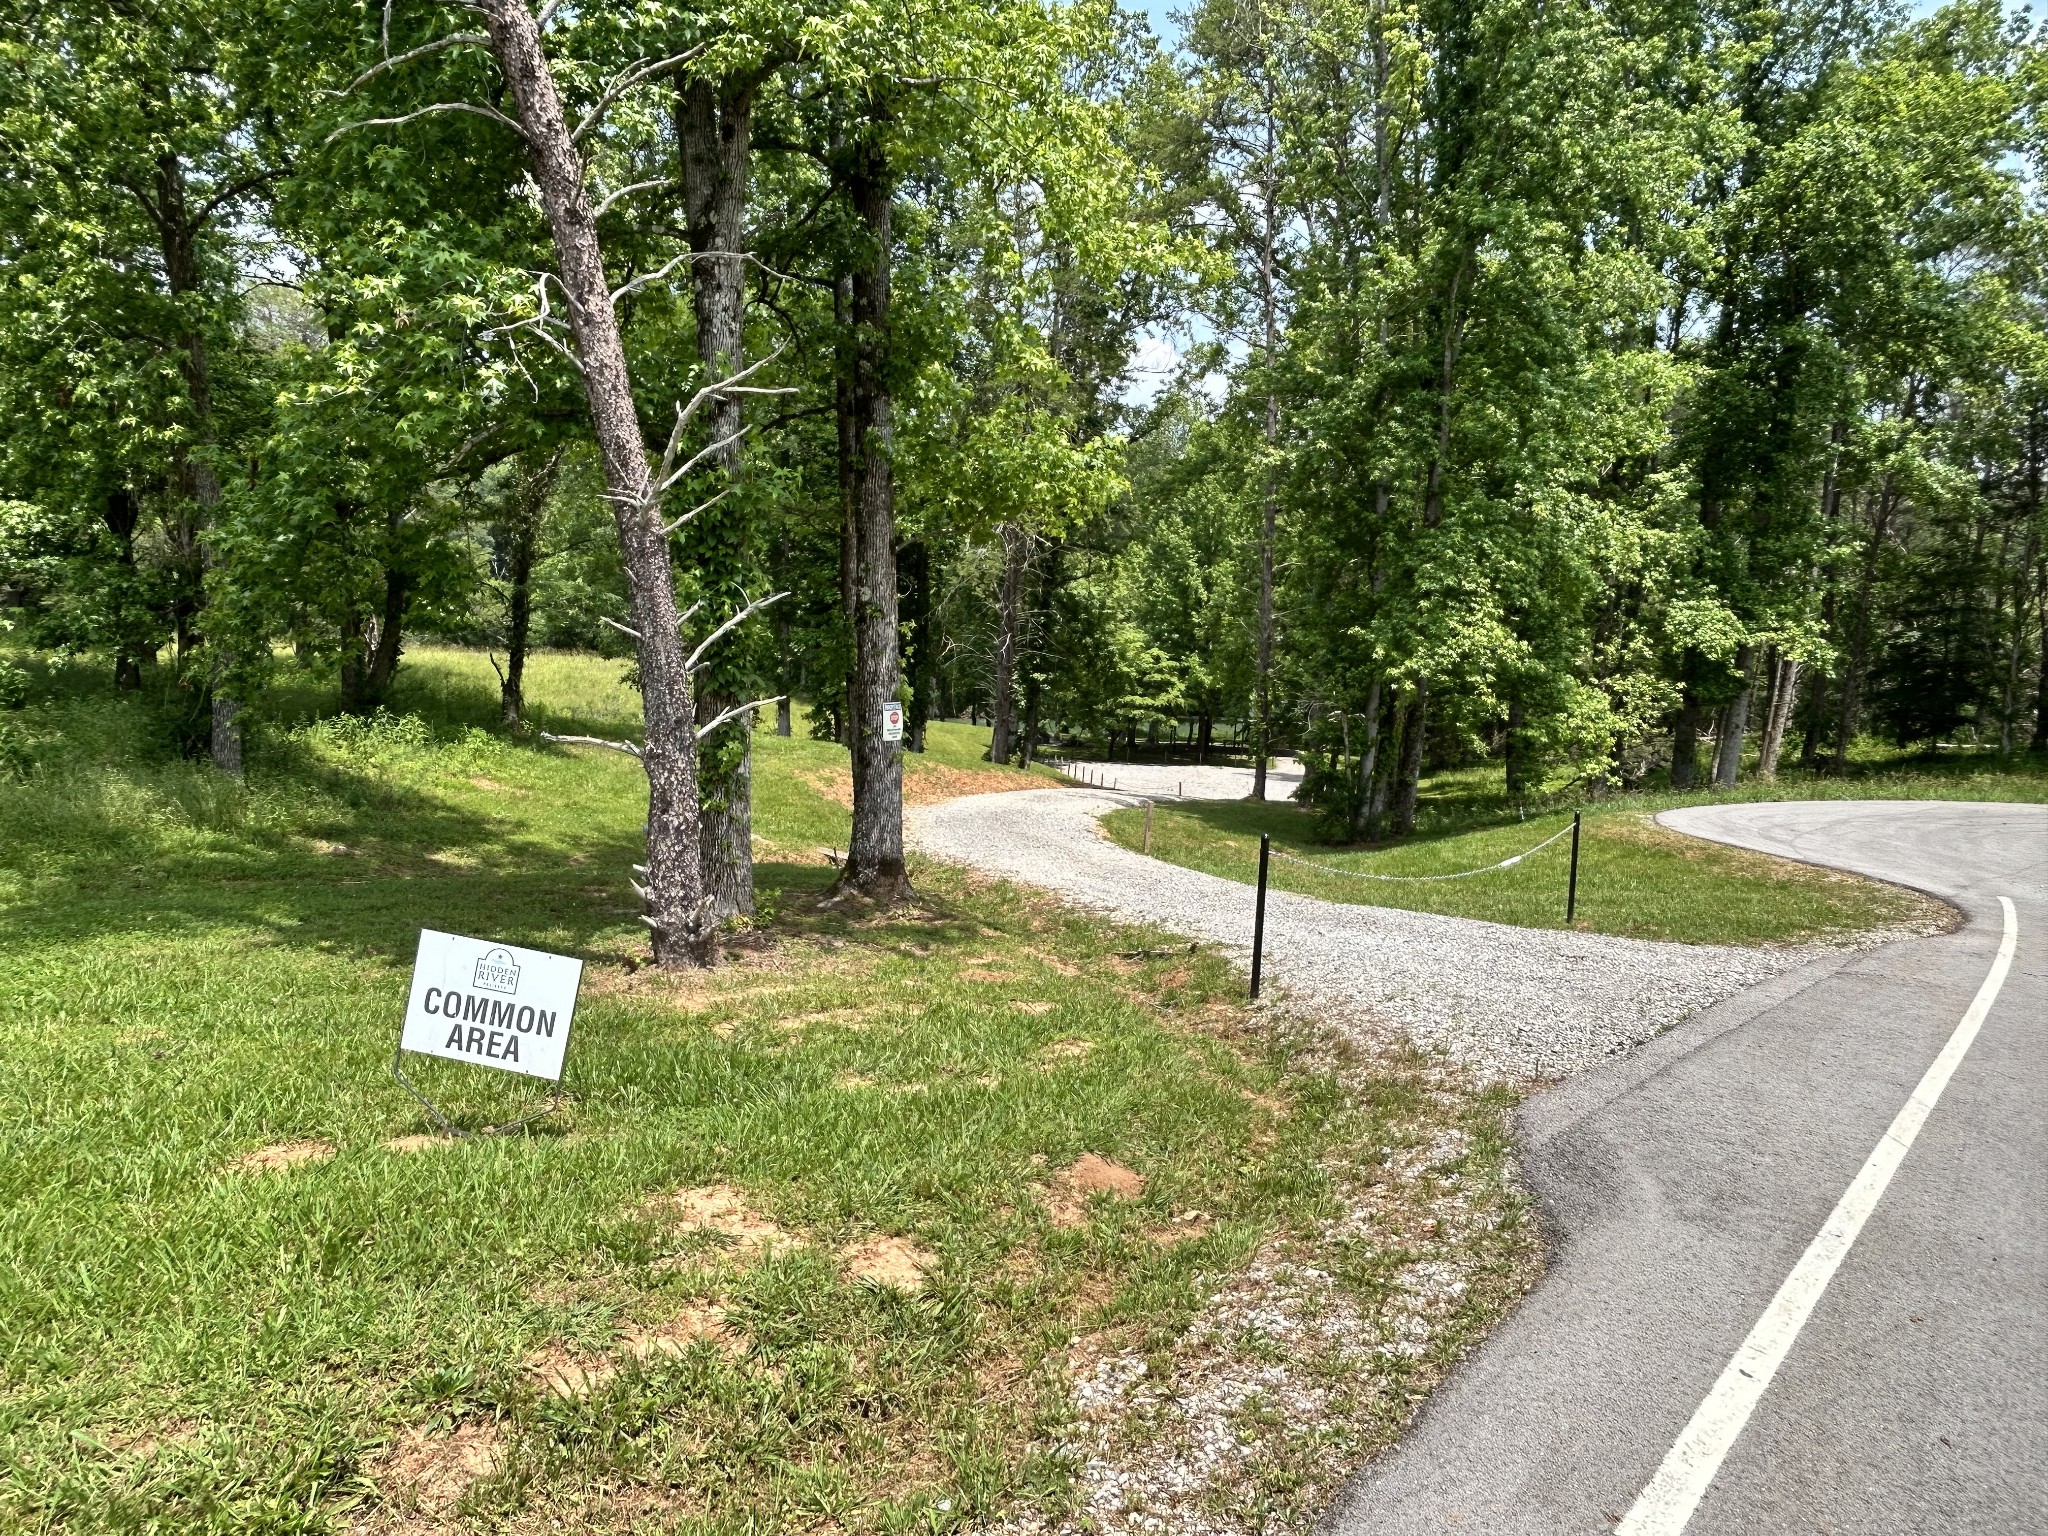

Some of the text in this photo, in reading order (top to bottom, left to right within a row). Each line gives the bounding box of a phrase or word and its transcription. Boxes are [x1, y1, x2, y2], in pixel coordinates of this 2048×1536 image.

[477, 970, 514, 986] RIVER
[479, 963, 517, 976] HIDDEN
[424, 987, 557, 1037] COMMON
[445, 1023, 520, 1063] AREA
